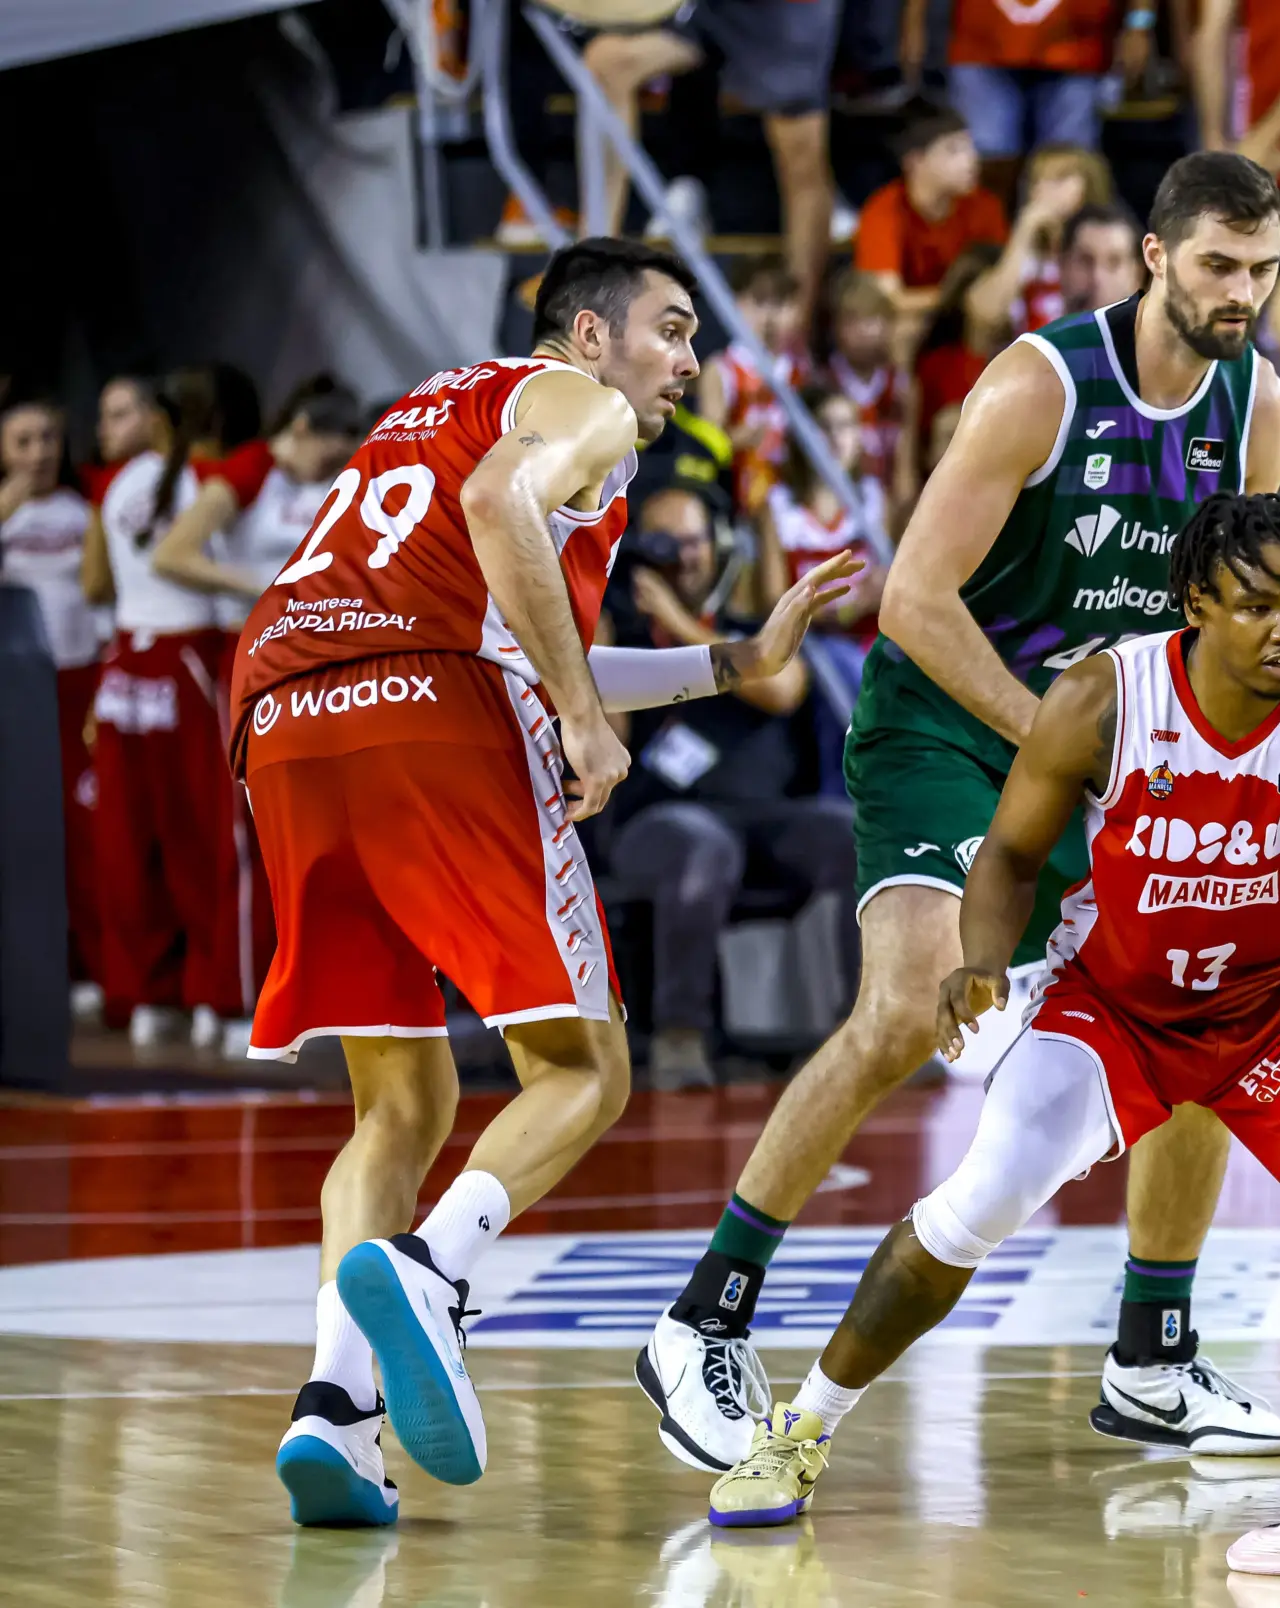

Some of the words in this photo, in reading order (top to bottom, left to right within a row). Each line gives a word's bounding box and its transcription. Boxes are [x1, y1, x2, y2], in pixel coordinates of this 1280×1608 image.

[1190, 457, 1222, 468] endesa
[1192, 447, 1208, 459] liga
[274, 463, 436, 586] 29
[1147, 876, 1275, 908] MANRESA
[1166, 942, 1237, 991] 13
